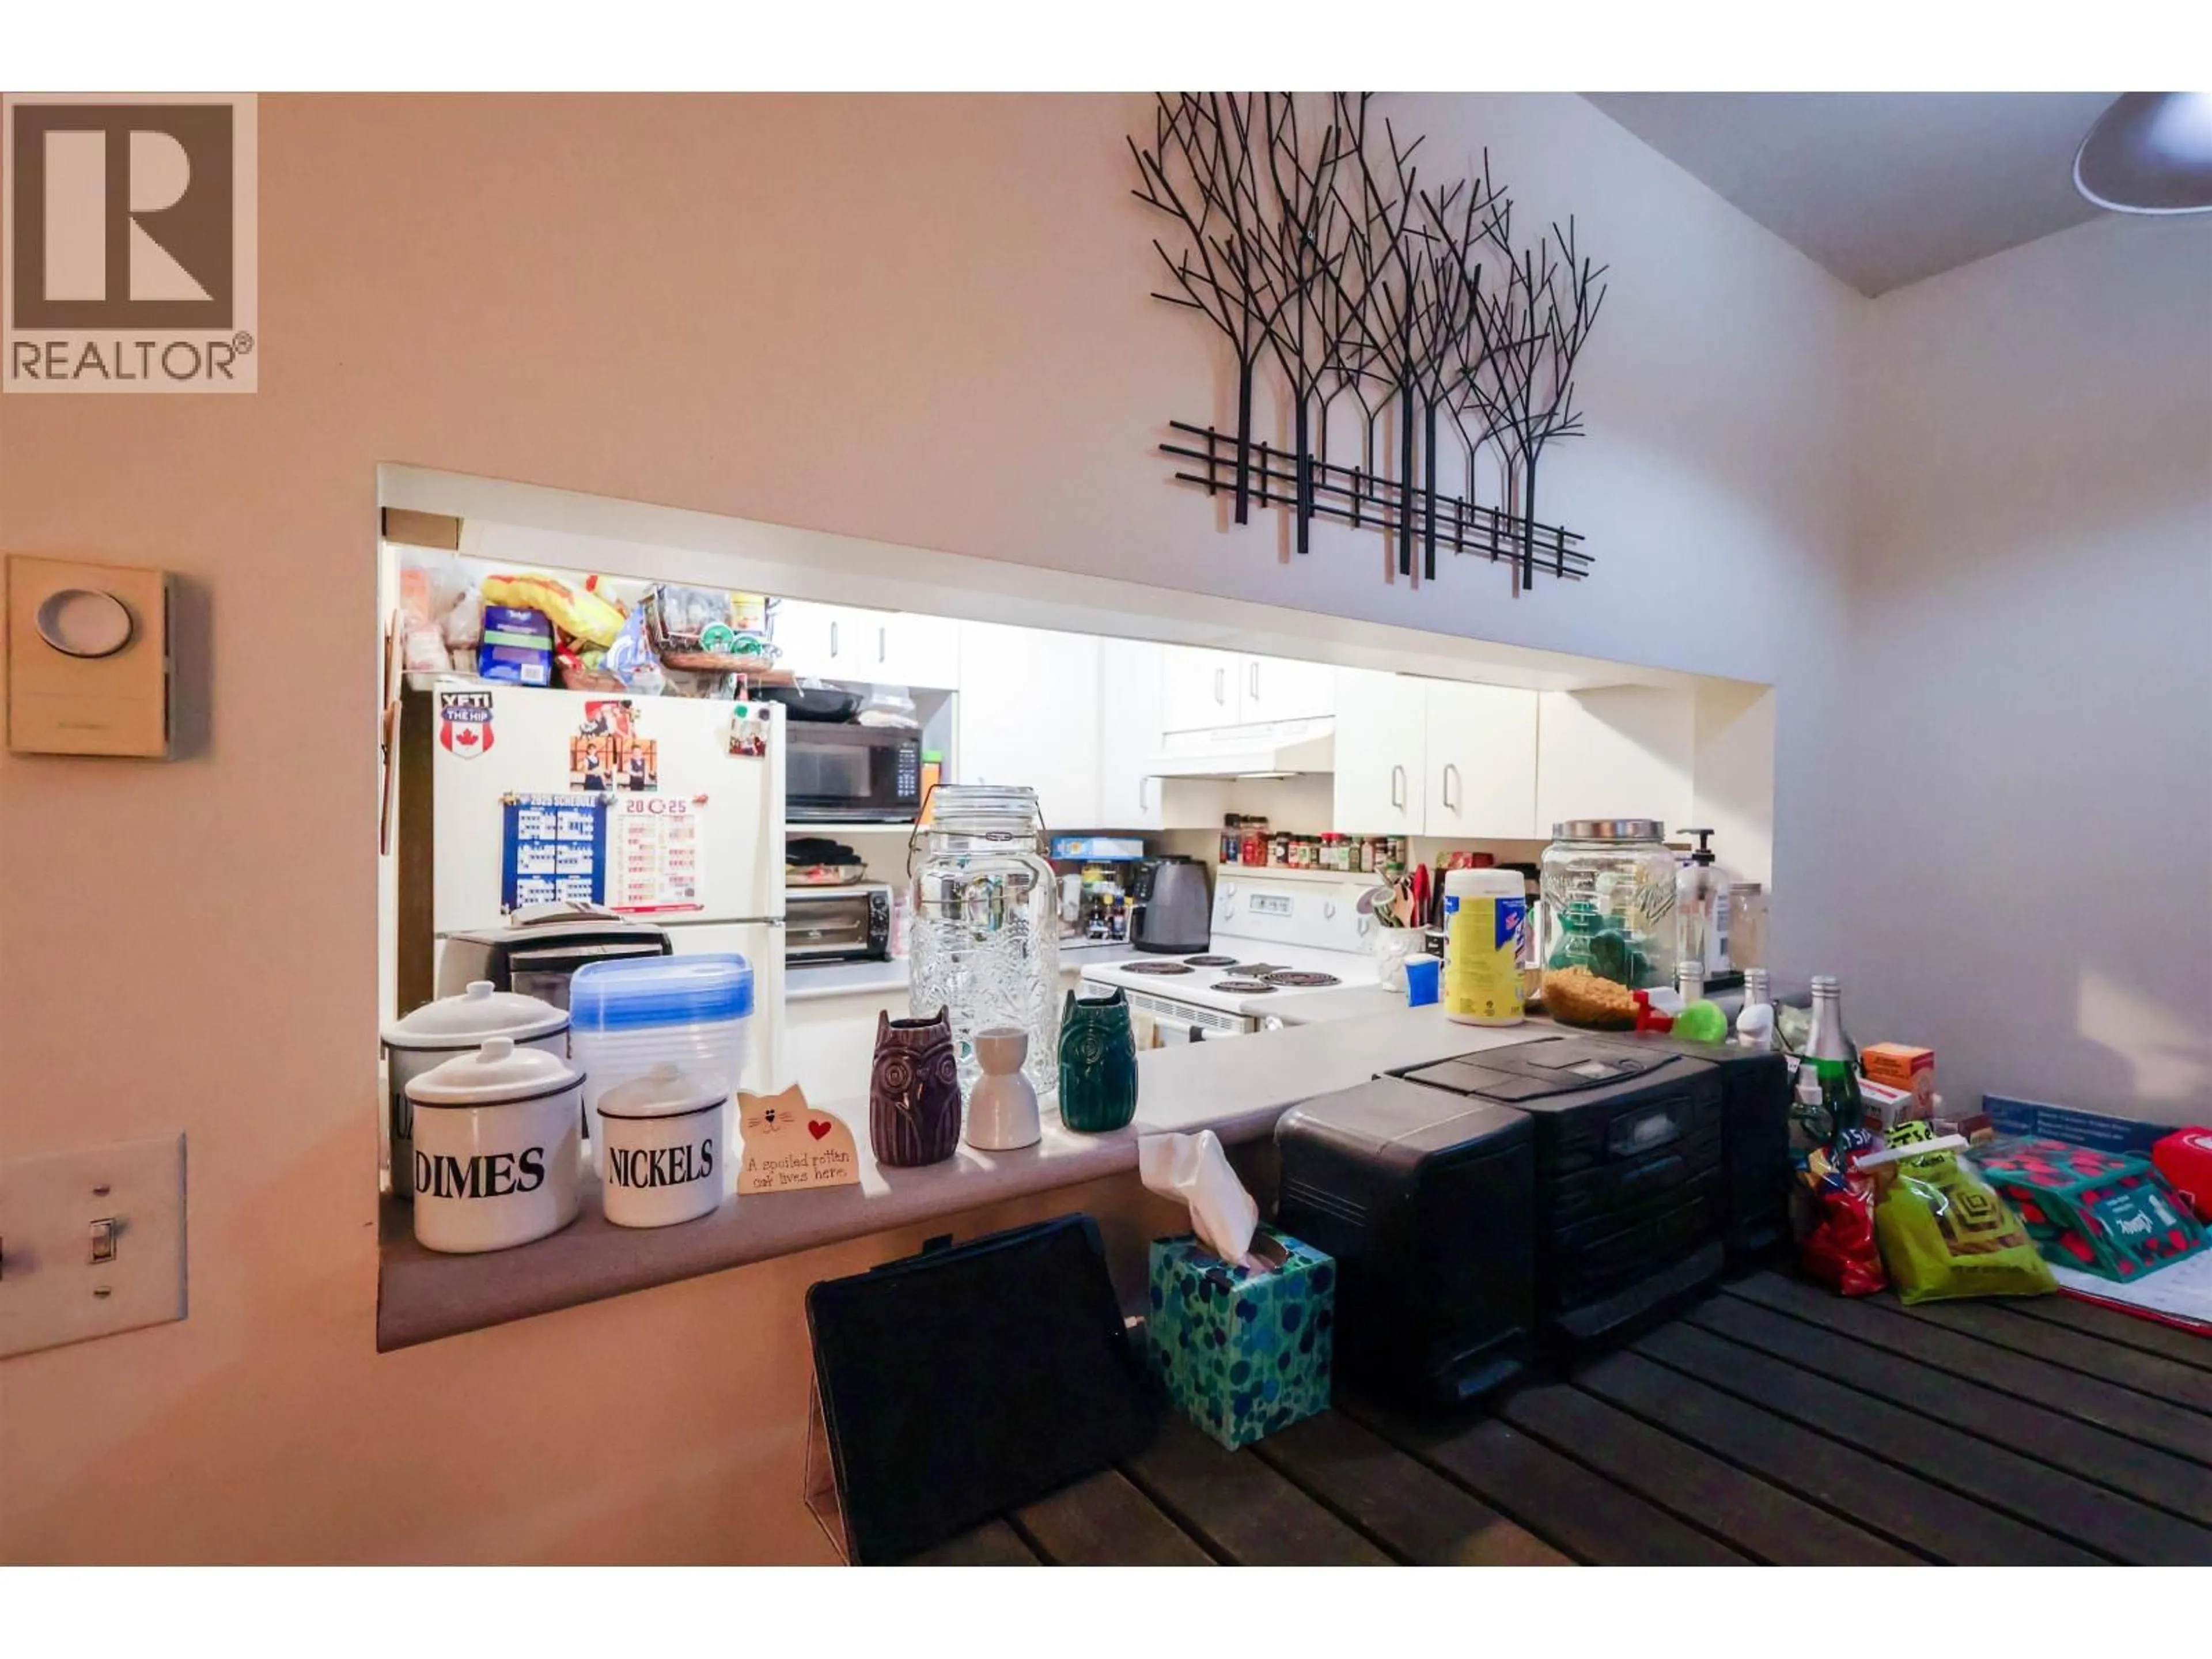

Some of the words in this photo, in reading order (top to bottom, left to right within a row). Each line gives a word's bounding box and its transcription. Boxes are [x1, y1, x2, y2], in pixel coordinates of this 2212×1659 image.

[447, 709, 468, 720] THE
[415, 1147, 545, 1199] DIMES
[609, 1138, 713, 1188] NICKELS
[748, 1158, 757, 1172] A
[763, 1153, 809, 1174] spoiled
[812, 1150, 850, 1166] rotten
[779, 1172, 808, 1184] lives
